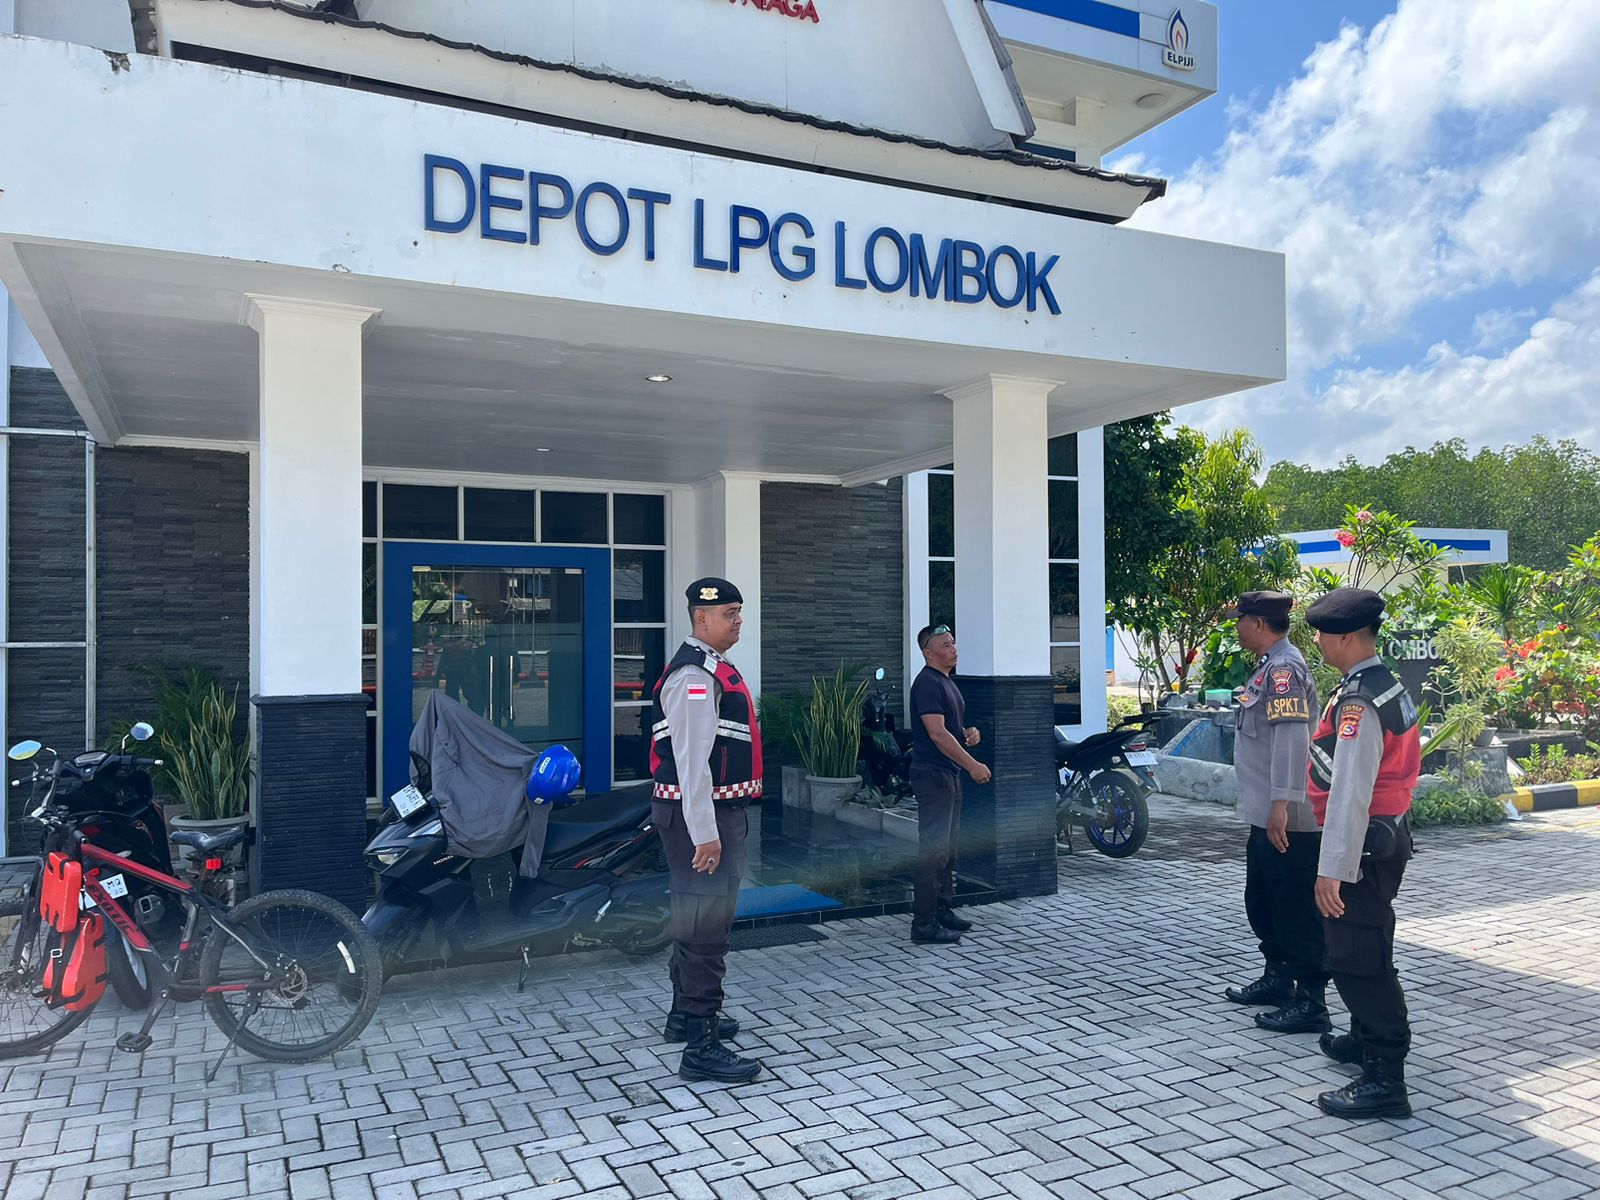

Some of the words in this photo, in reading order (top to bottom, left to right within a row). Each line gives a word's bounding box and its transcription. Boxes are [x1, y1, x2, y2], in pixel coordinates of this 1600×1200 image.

[1167, 51, 1194, 67] ELPIJI
[424, 153, 671, 262] DEPOT
[693, 197, 816, 282] LPG
[834, 220, 1062, 316] LOMBOK
[1273, 697, 1299, 713] SPKT
